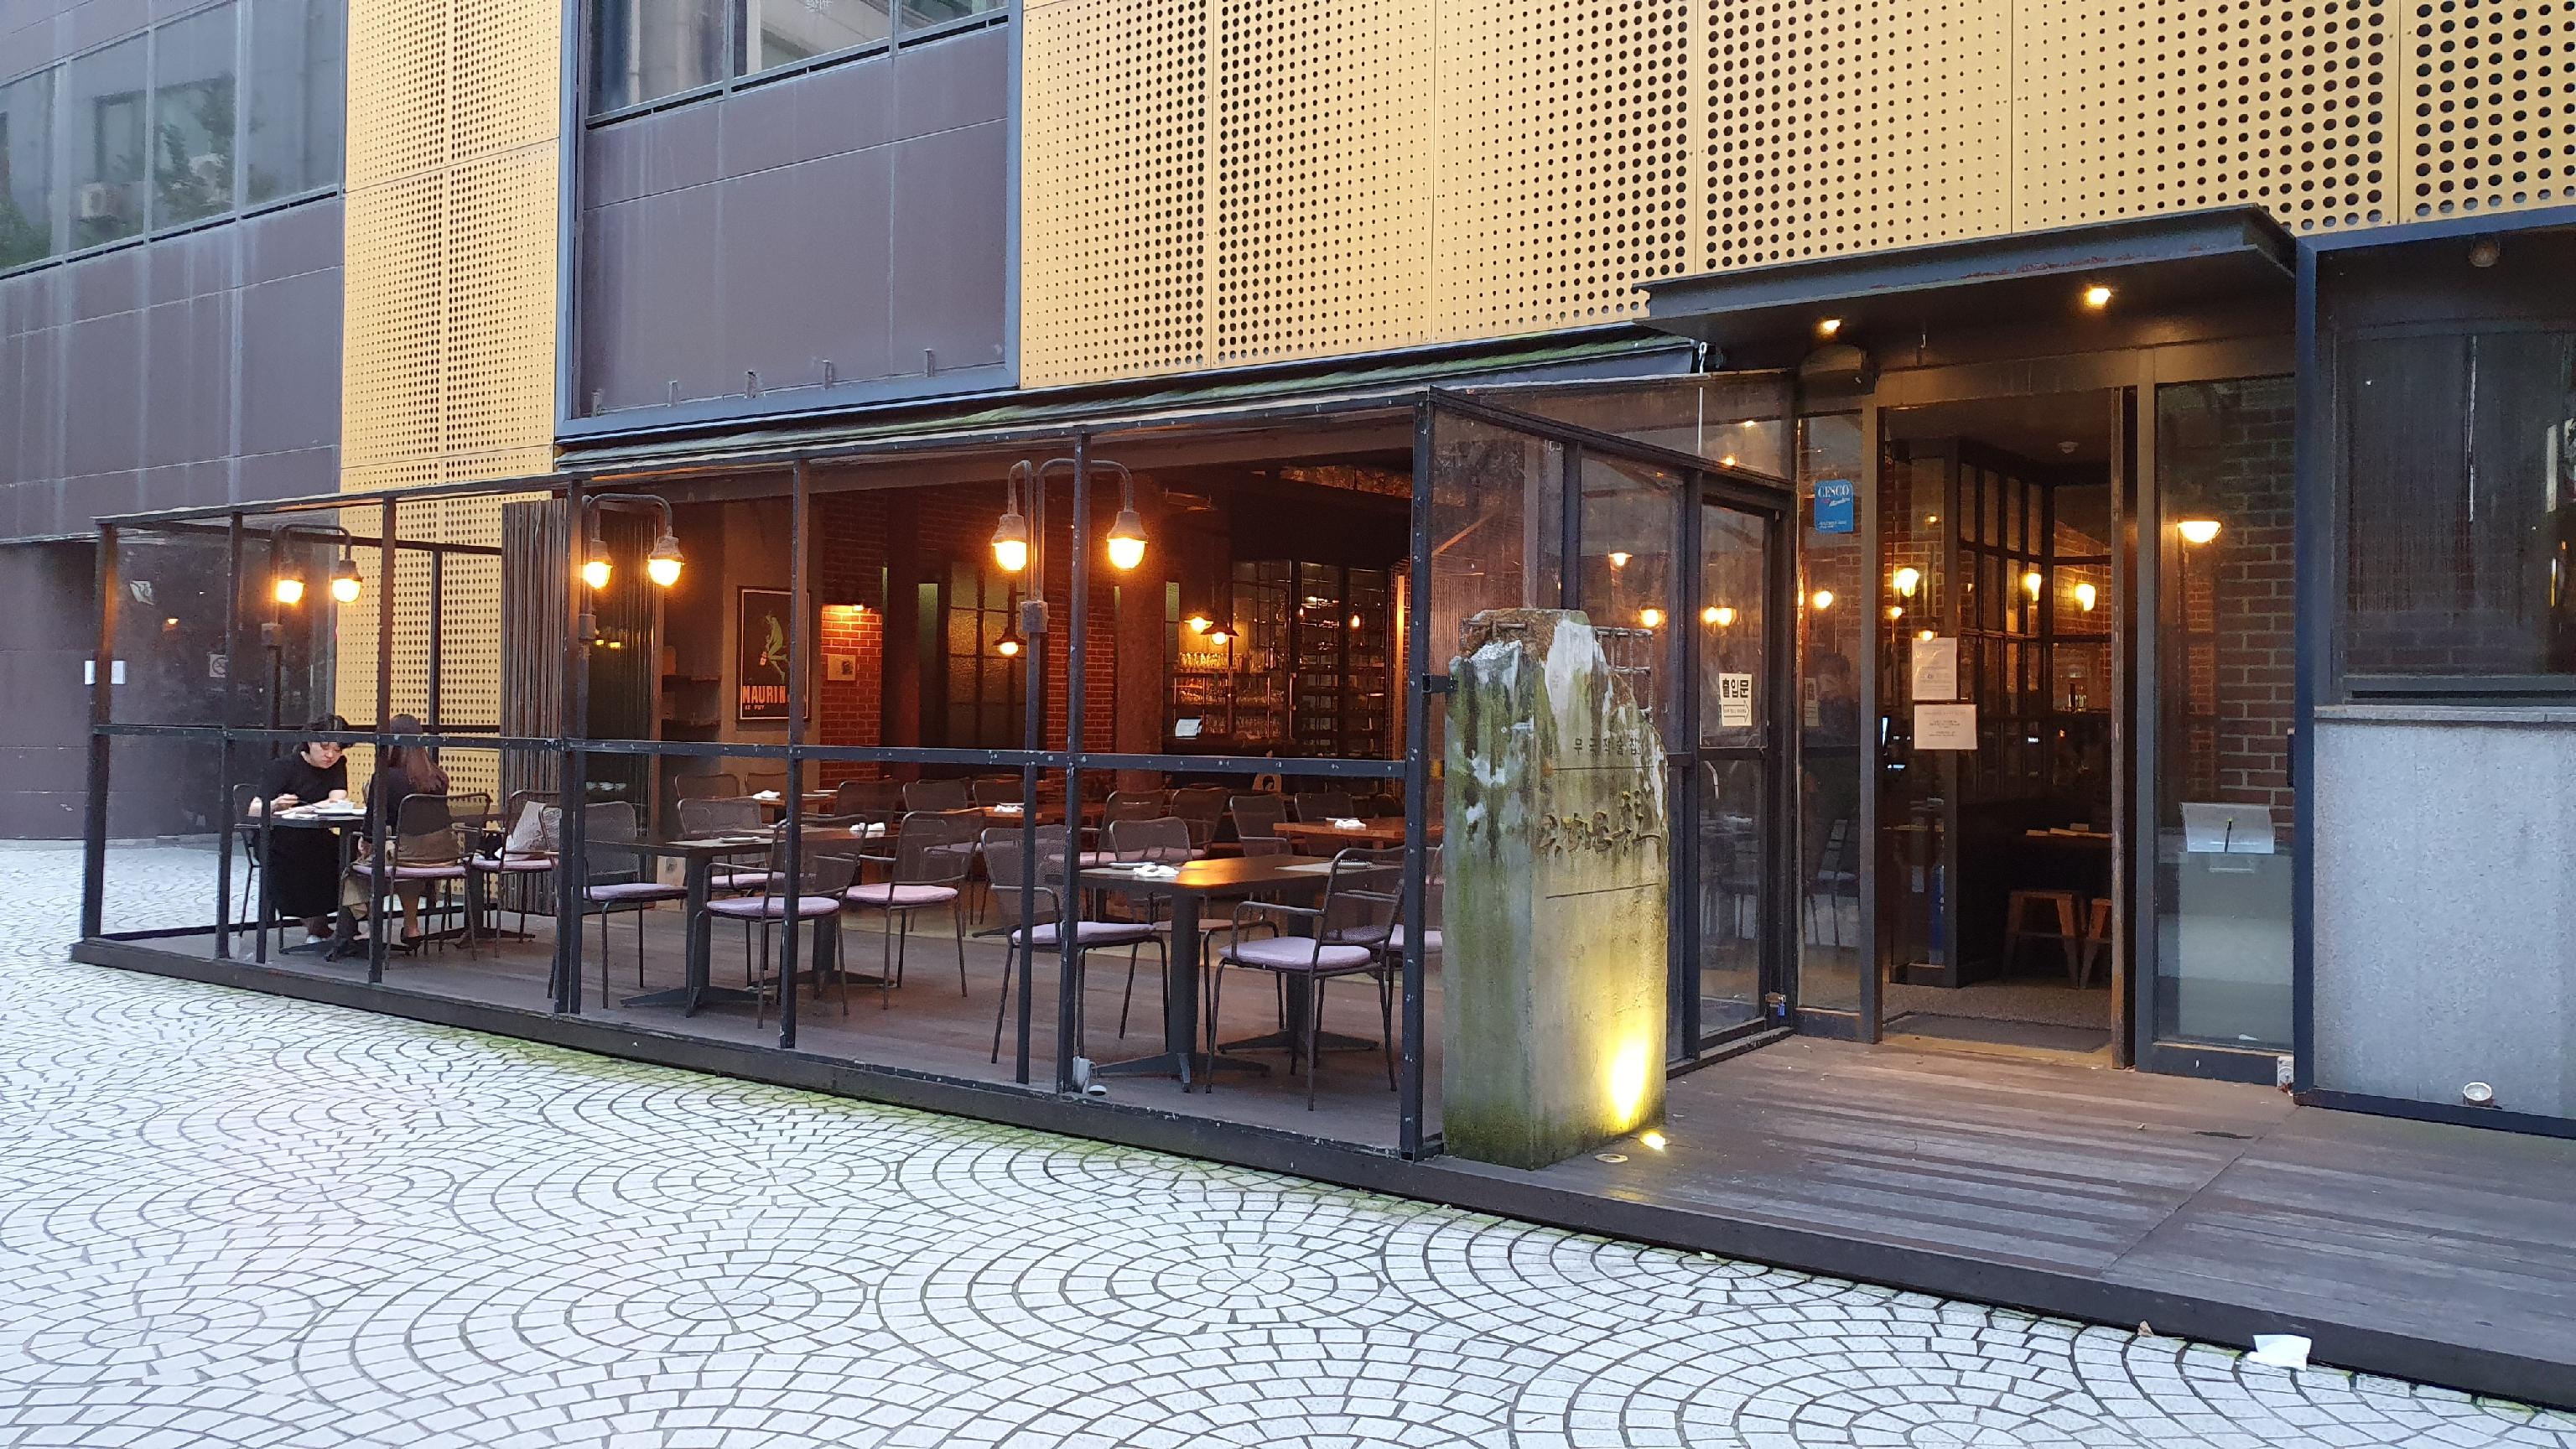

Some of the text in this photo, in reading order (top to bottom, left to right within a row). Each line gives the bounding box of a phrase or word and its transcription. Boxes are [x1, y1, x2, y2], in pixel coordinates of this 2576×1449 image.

[1817, 485, 1850, 497] CESCO
[743, 686, 786, 704] MAURIN
[1722, 678, 1749, 698] 출입문
